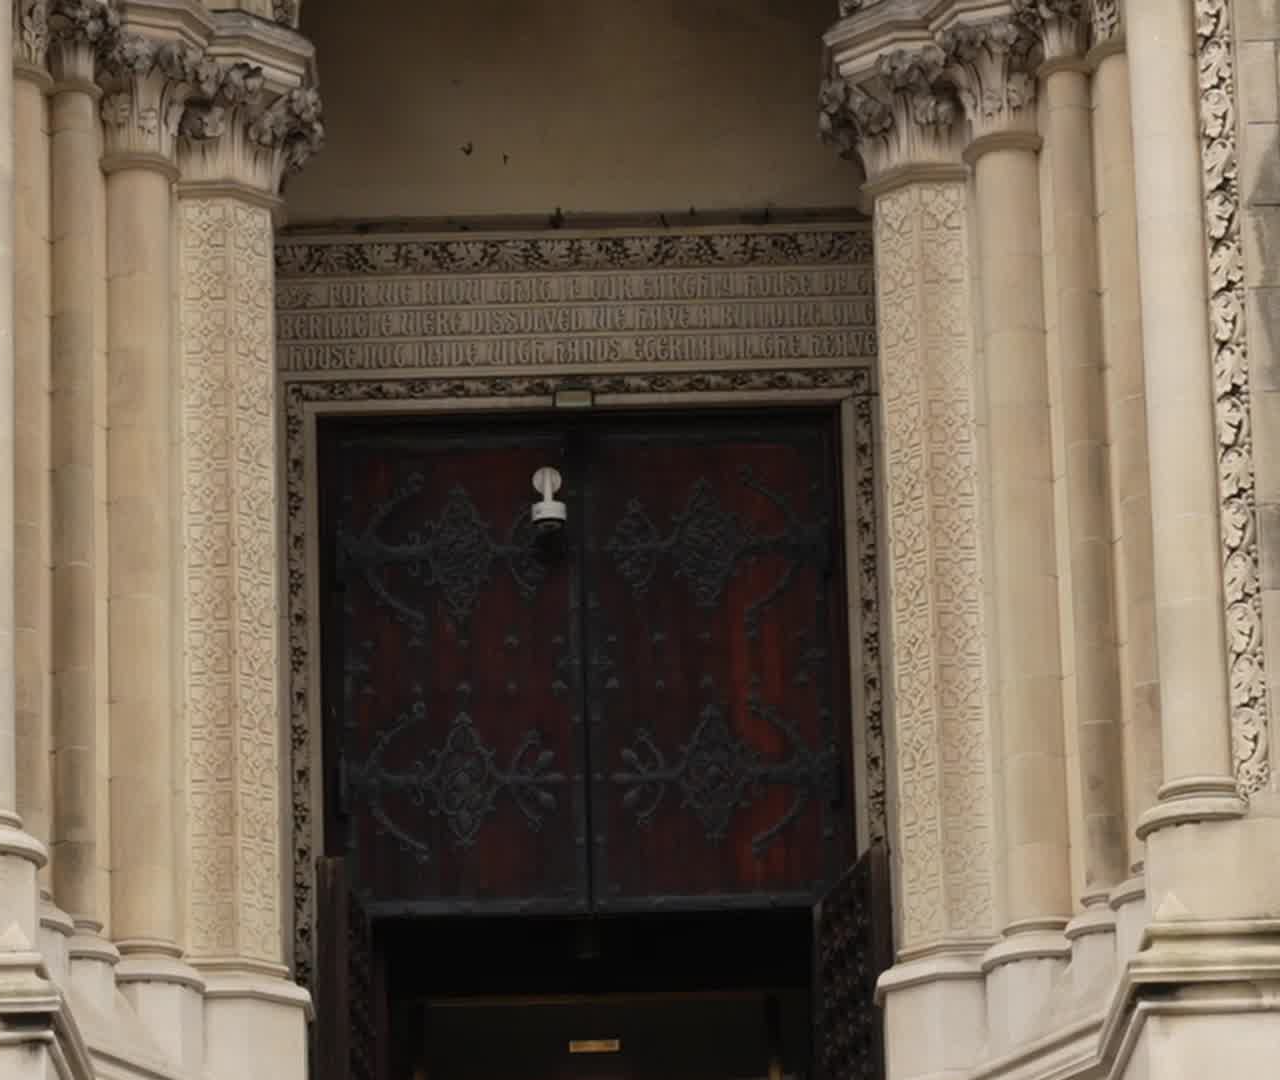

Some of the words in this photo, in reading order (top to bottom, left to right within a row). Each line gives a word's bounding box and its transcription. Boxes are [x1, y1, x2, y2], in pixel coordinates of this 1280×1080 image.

[328, 281, 369, 306] FOR
[375, 281, 412, 305] WE
[744, 272, 811, 297] HOUSE
[399, 311, 464, 337] WERE
[288, 344, 359, 370] HOUSE
[810, 331, 879, 357] HEAVE
